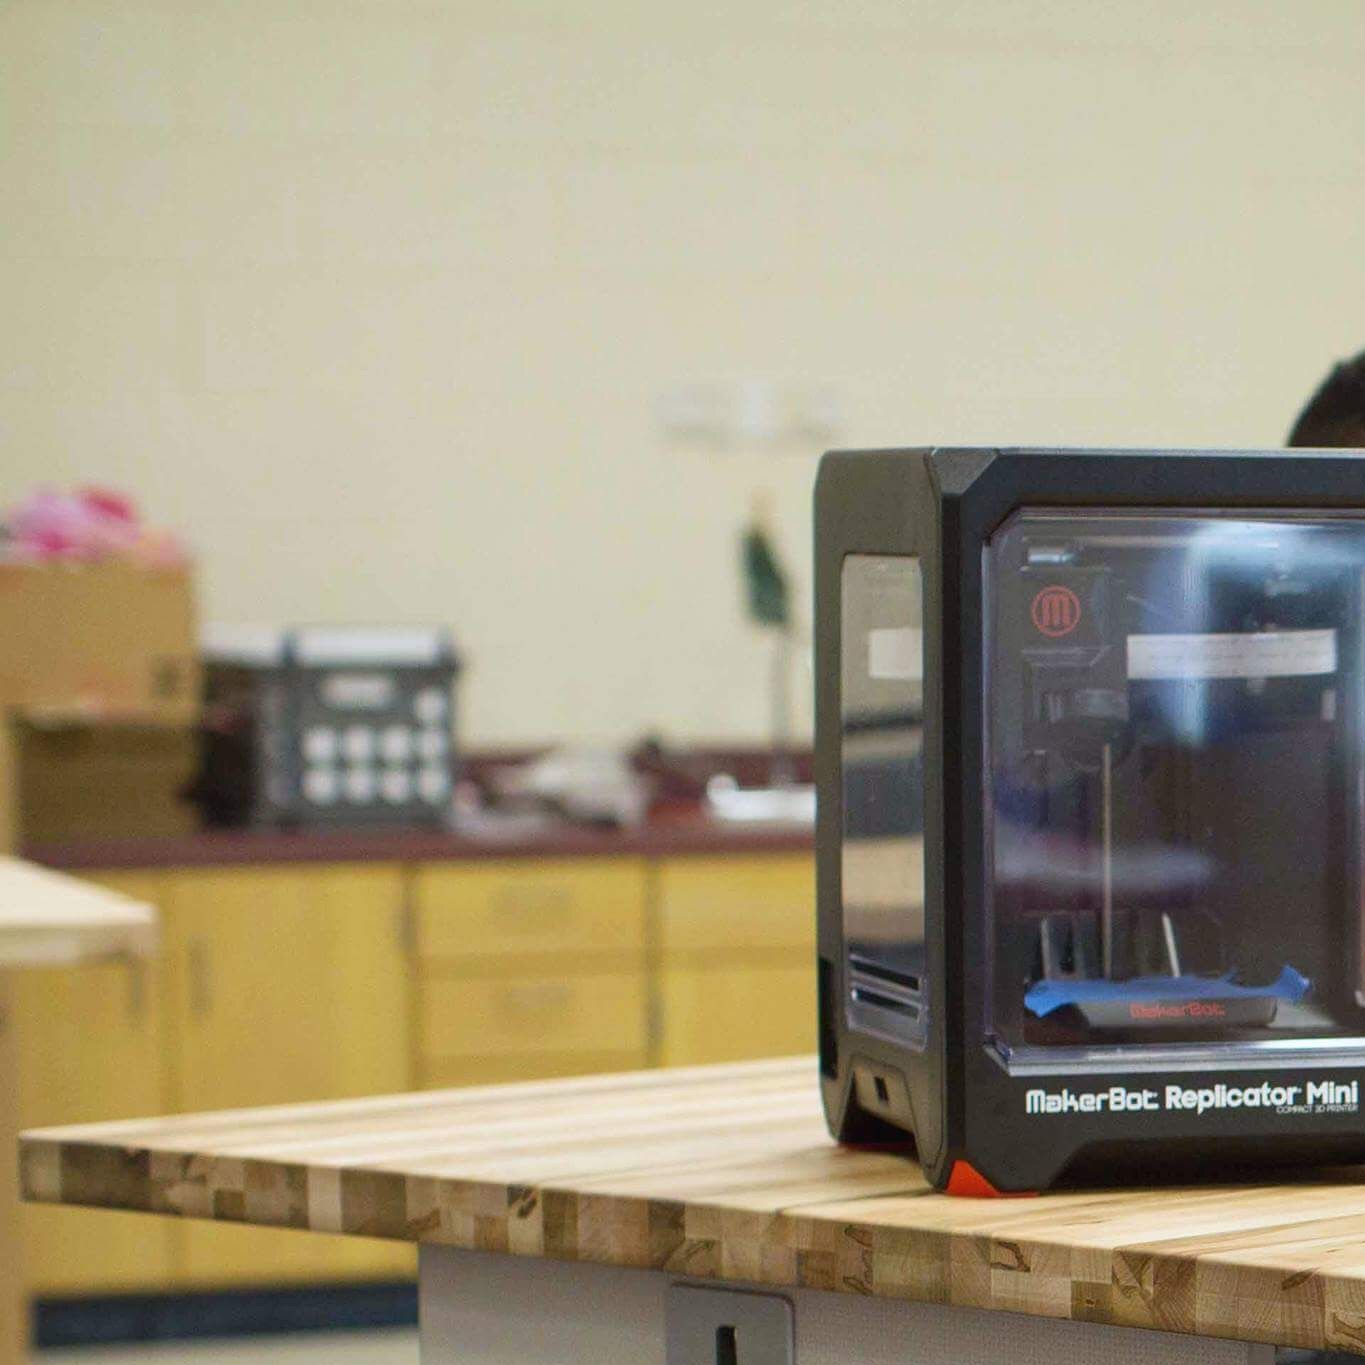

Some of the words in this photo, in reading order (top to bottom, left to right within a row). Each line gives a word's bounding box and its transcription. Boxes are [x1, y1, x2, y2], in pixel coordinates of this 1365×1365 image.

[1026, 1087, 1159, 1114] MakerBot
[1165, 1082, 1300, 1115] Replicator
[1307, 1080, 1359, 1105] Mini
[1276, 1104, 1312, 1113] COMPACT
[1327, 1103, 1359, 1113] PRINTER
